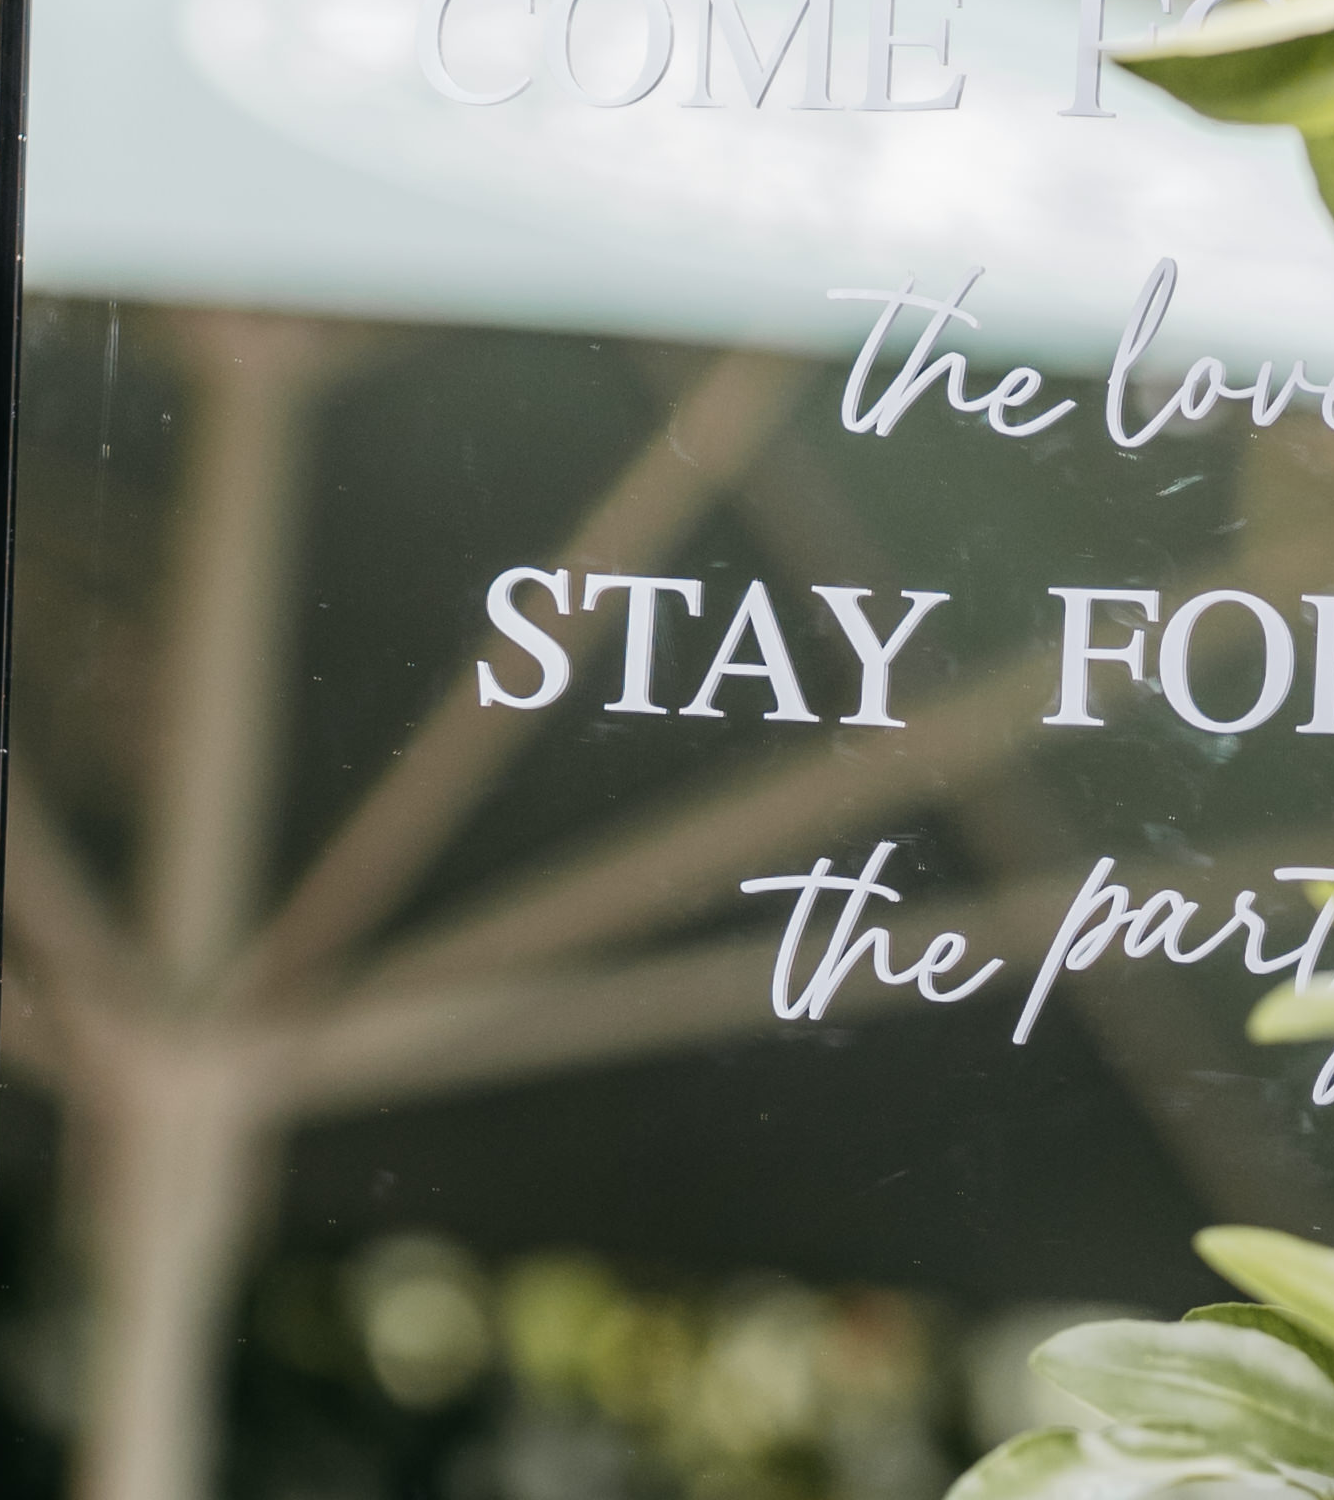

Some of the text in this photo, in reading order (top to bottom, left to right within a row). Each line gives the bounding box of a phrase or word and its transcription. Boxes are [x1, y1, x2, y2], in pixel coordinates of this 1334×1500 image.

[826, 265, 1077, 438] the
[476, 566, 951, 729] STAY
[739, 841, 1005, 1021] the
